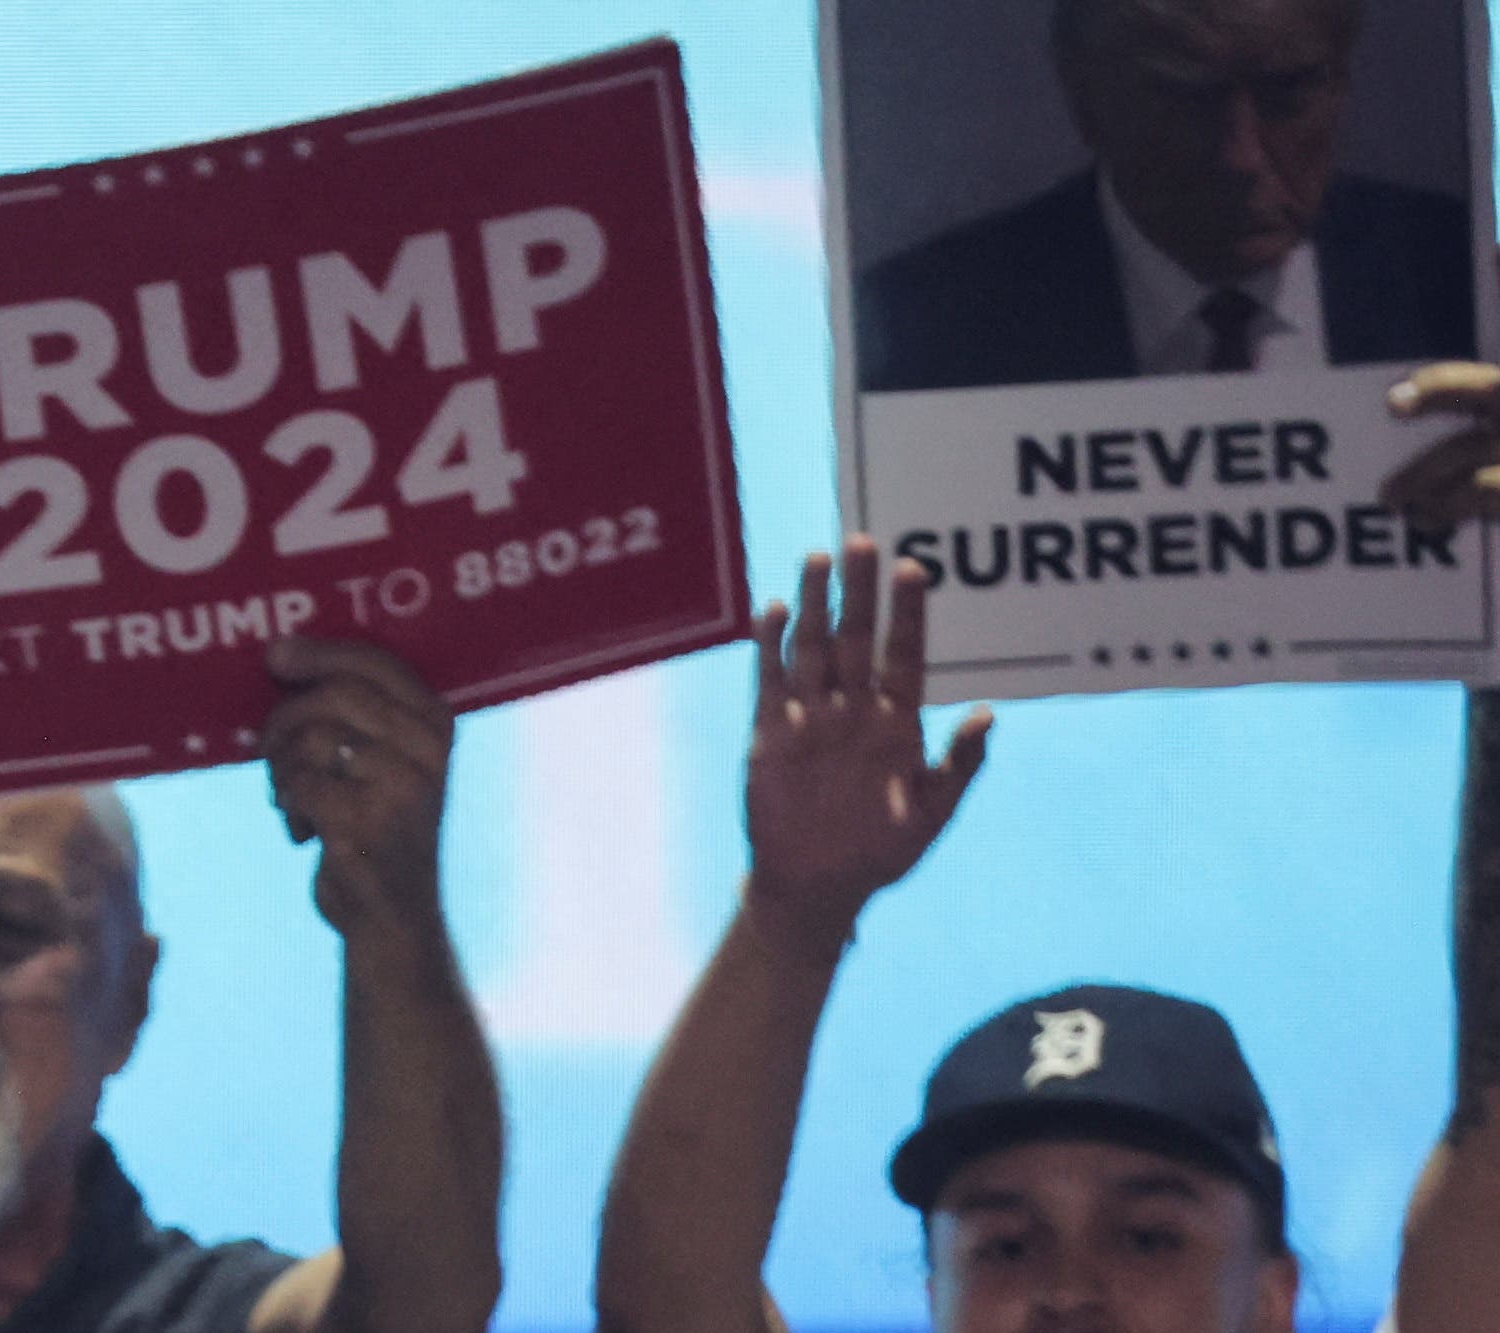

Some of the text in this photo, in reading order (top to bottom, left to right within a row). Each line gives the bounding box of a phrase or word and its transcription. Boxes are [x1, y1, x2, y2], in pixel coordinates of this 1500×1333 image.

[1016, 419, 1330, 497] NEVER
[70, 590, 315, 664] TRUMP
[335, 567, 432, 626] TO
[454, 508, 661, 600] 88022
